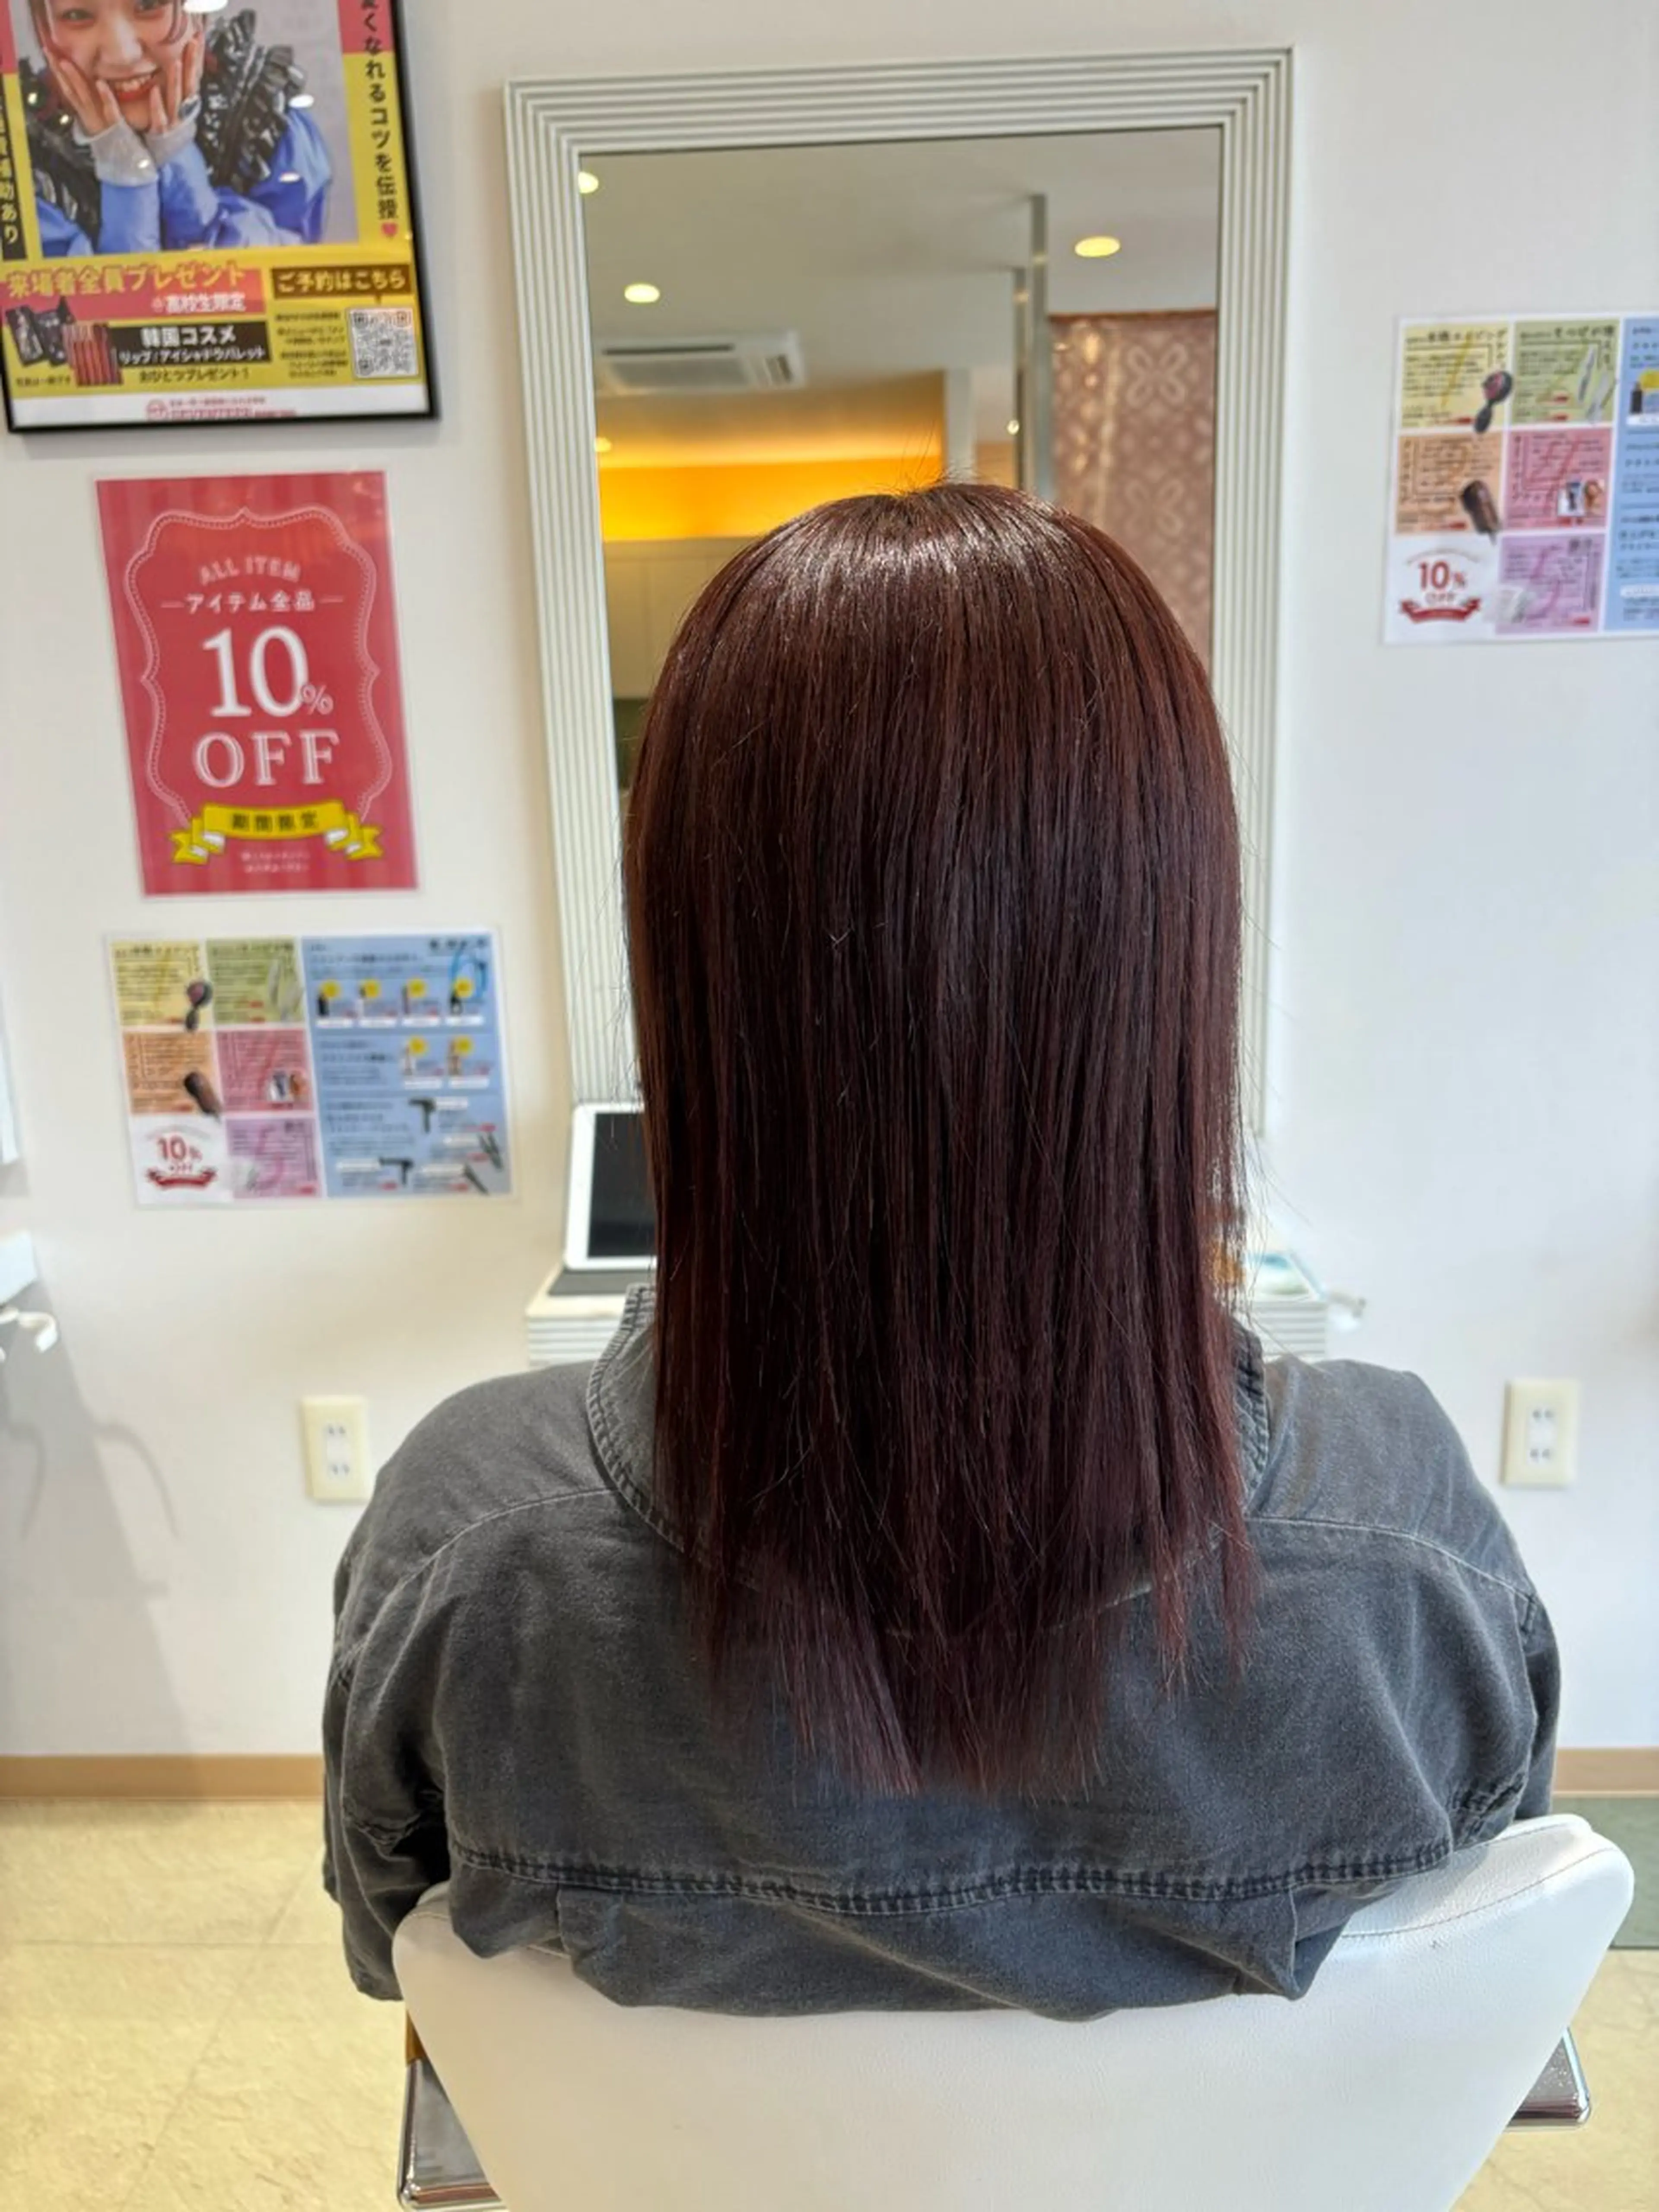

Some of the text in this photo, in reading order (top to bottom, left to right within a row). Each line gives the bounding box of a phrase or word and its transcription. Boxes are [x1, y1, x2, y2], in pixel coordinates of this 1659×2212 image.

[7, 262, 245, 298] 来場者全員プレゼント
[277, 267, 407, 292] ご予約はこちら
[140, 325, 236, 347] 韓国コスメ
[199, 555, 301, 586] ALL ITEM
[186, 589, 315, 614] アイテム全品
[193, 728, 340, 788] OFF
